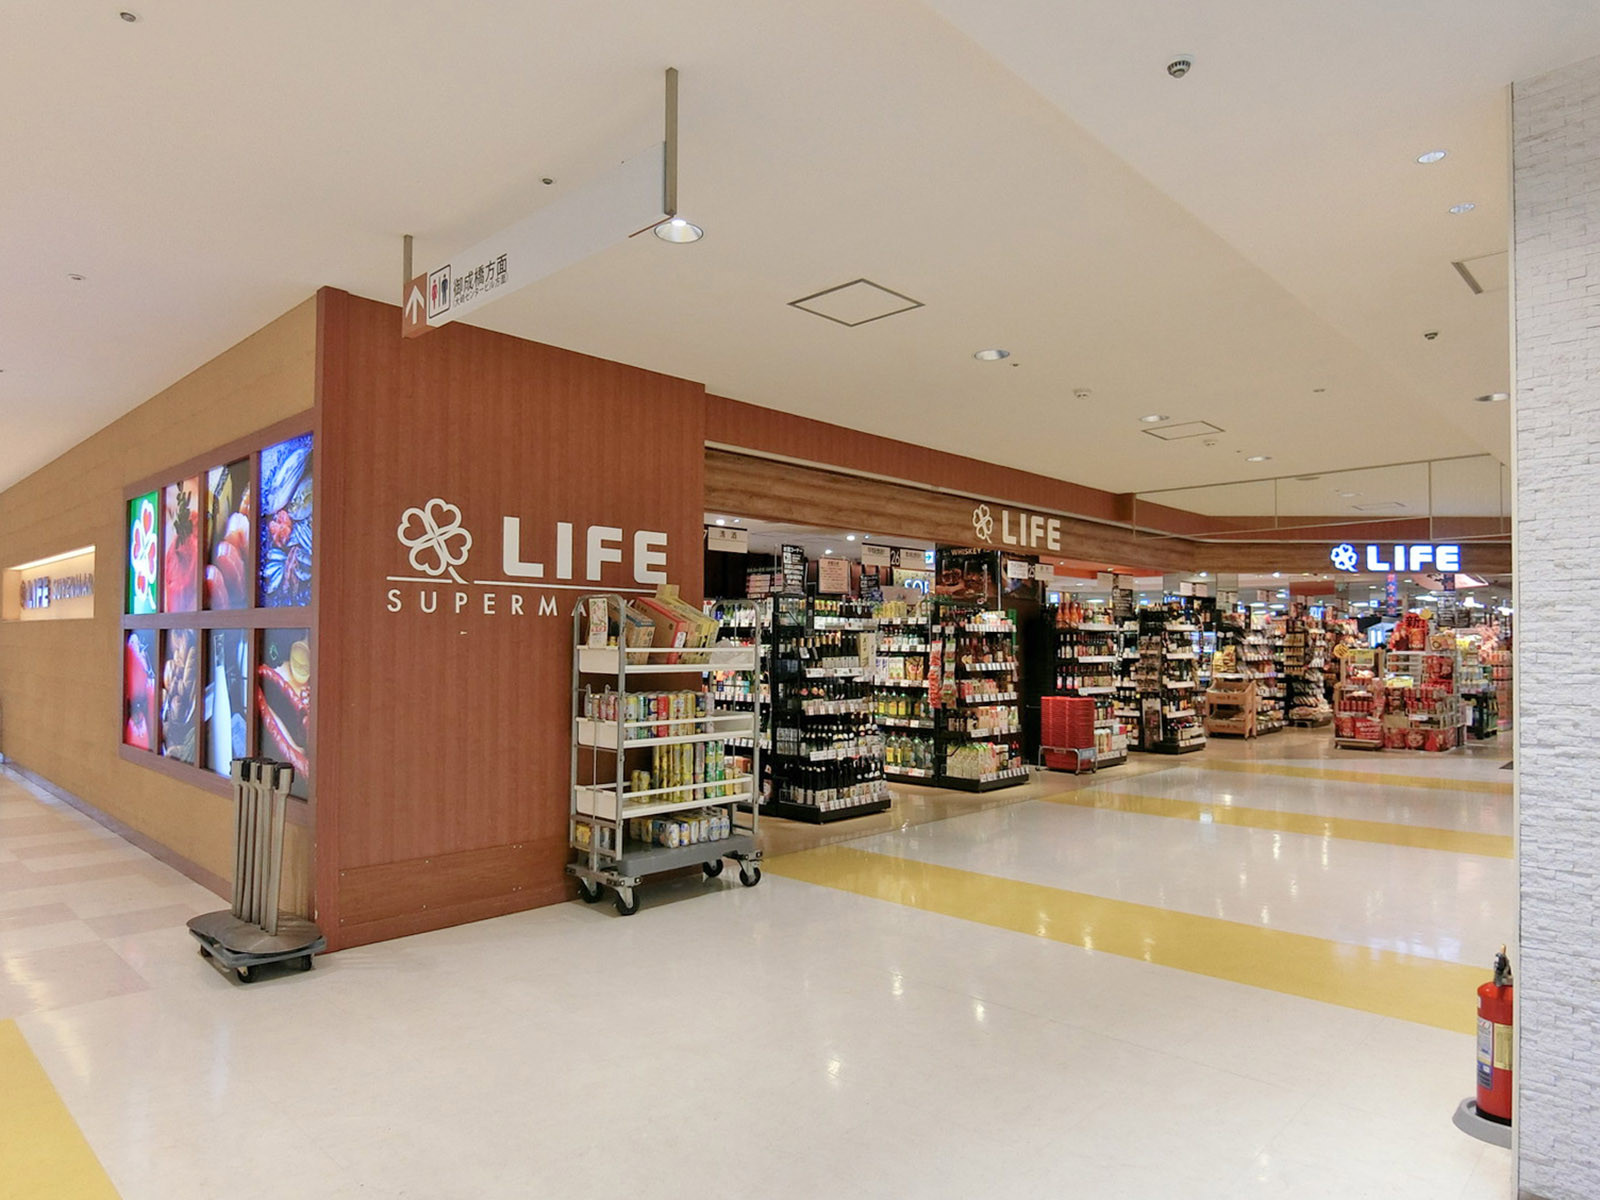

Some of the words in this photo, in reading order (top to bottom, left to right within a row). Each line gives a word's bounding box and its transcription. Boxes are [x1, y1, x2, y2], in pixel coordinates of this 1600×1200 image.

[503, 516, 667, 585] LIFE
[1003, 510, 1060, 551] LIFE
[1366, 545, 1461, 572] LIFE
